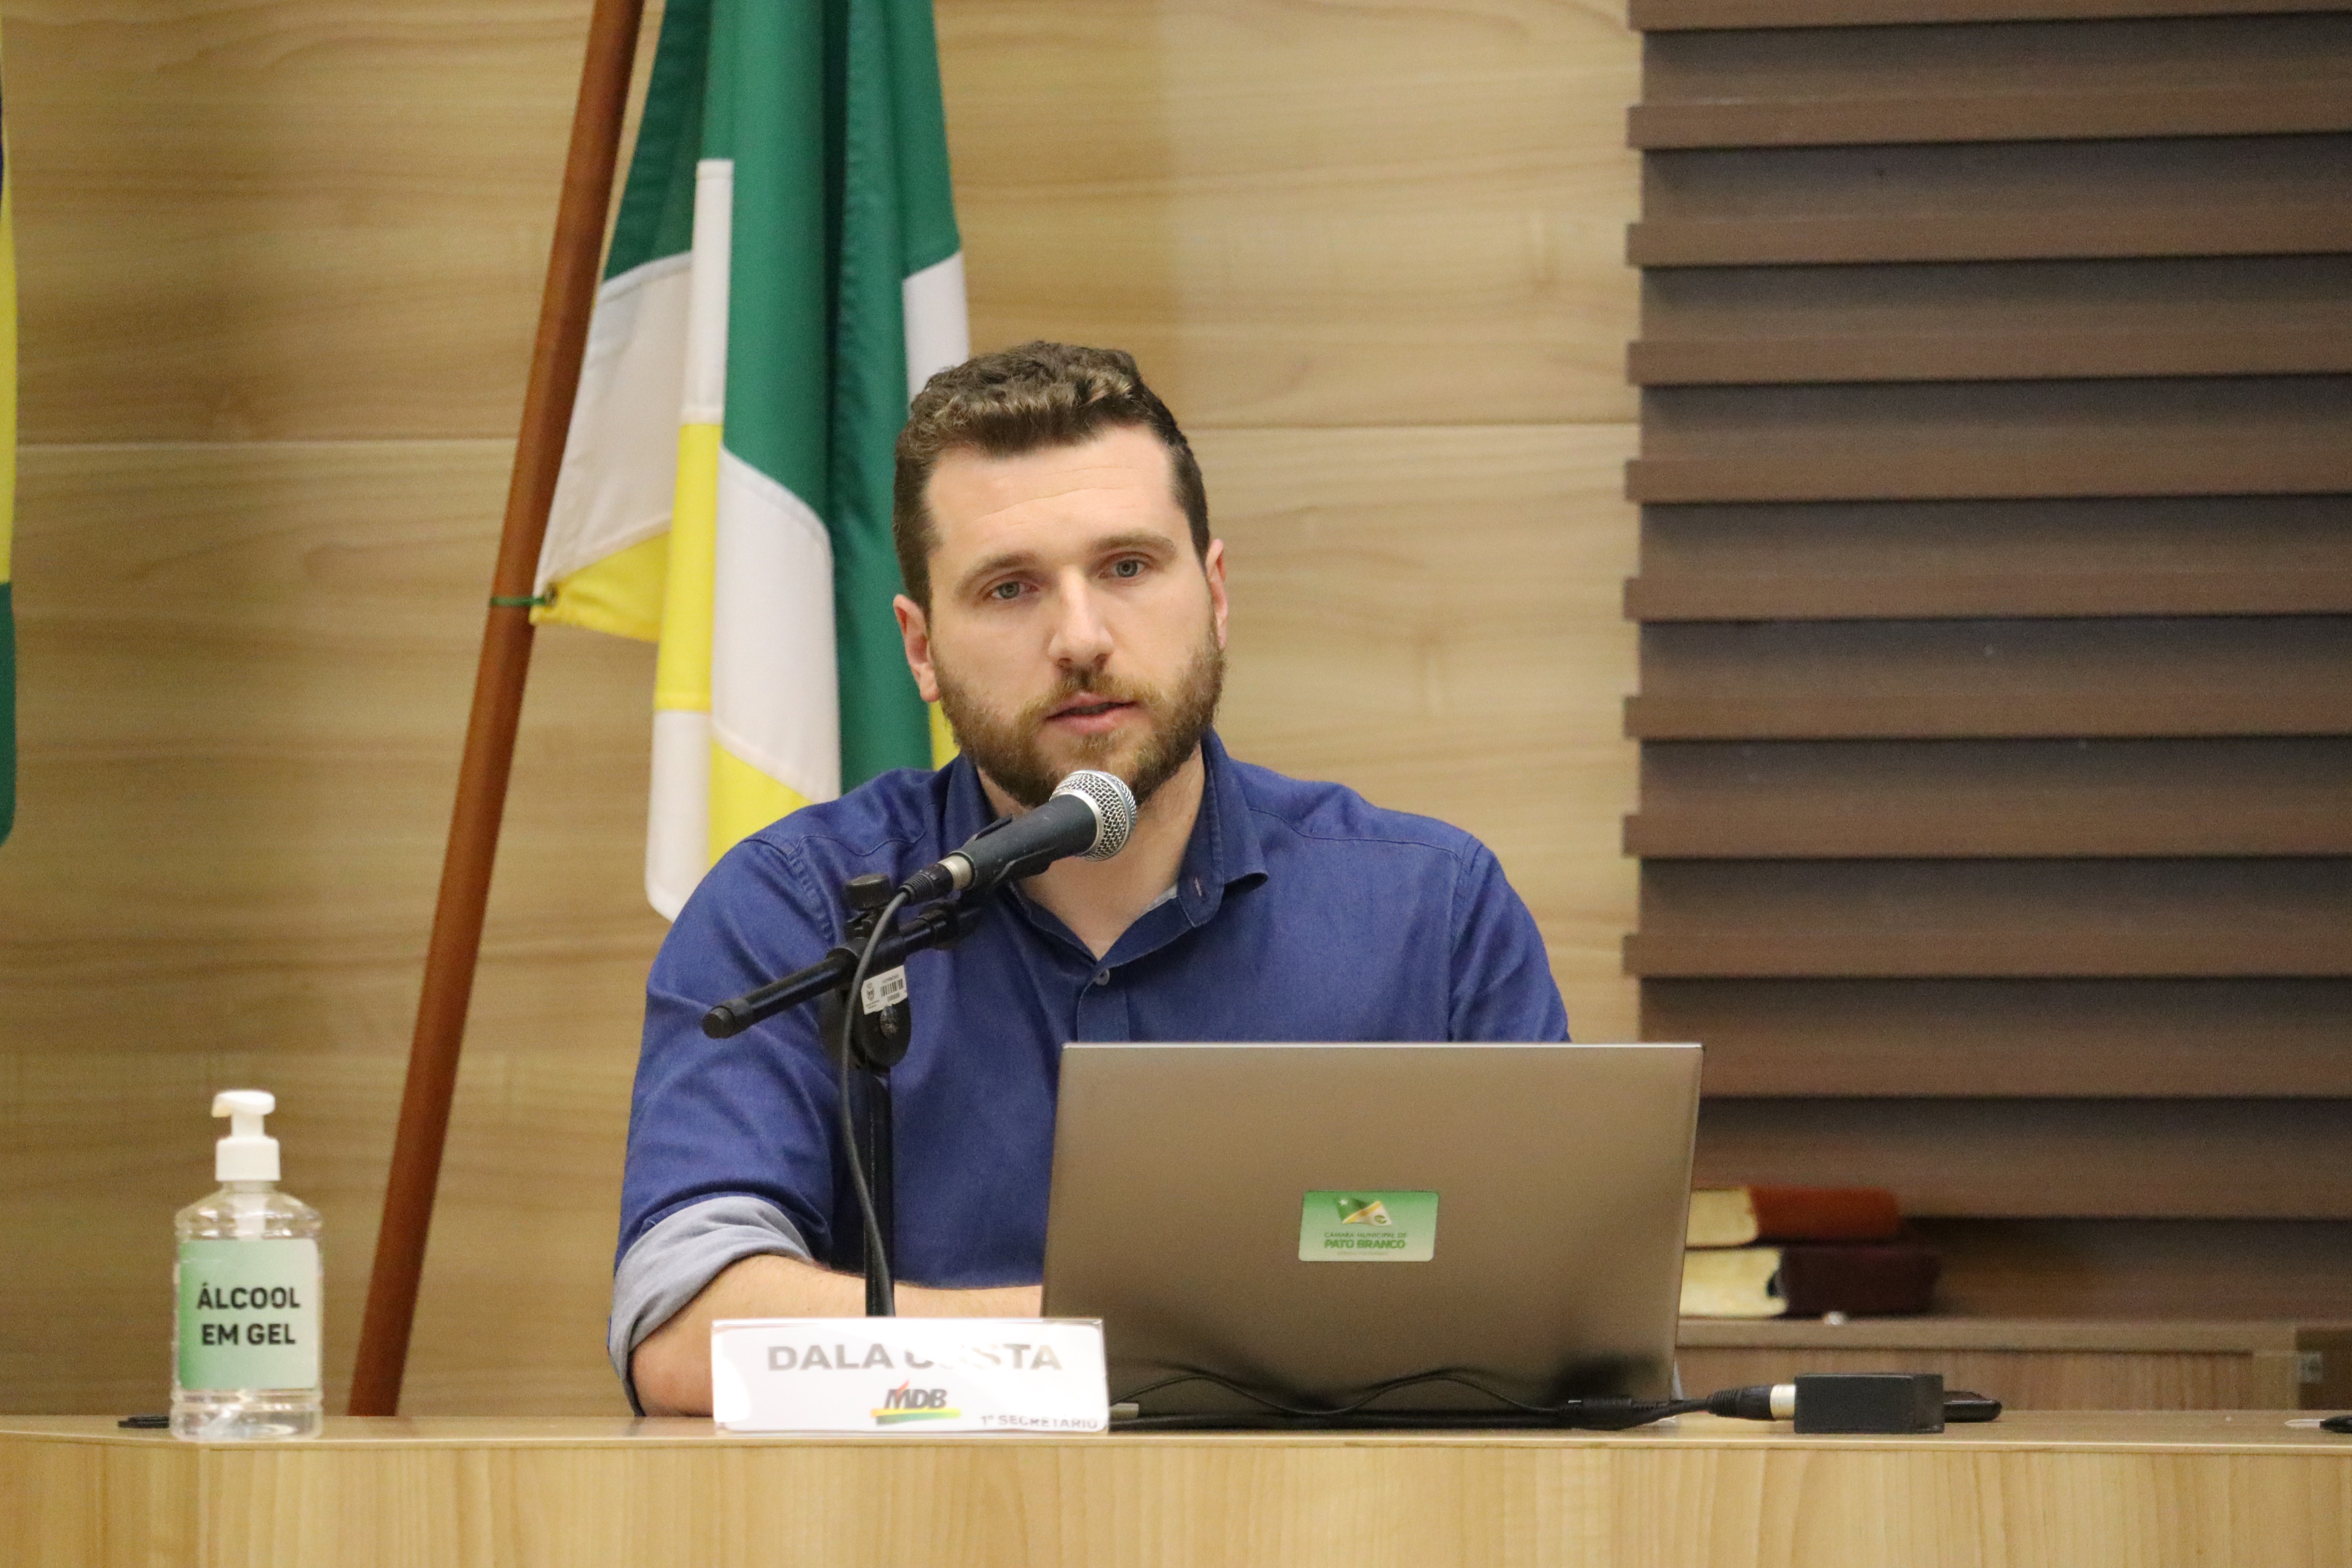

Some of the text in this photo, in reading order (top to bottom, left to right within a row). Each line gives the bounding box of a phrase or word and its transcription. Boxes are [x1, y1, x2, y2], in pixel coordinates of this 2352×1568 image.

[1325, 1239, 1406, 1249] PATO BRANCO
[197, 1283, 300, 1310] ÁLCOOL
[202, 1323, 296, 1345] EM GEL
[768, 1343, 1063, 1371] DALA CSTA
[884, 1387, 947, 1410] MDB
